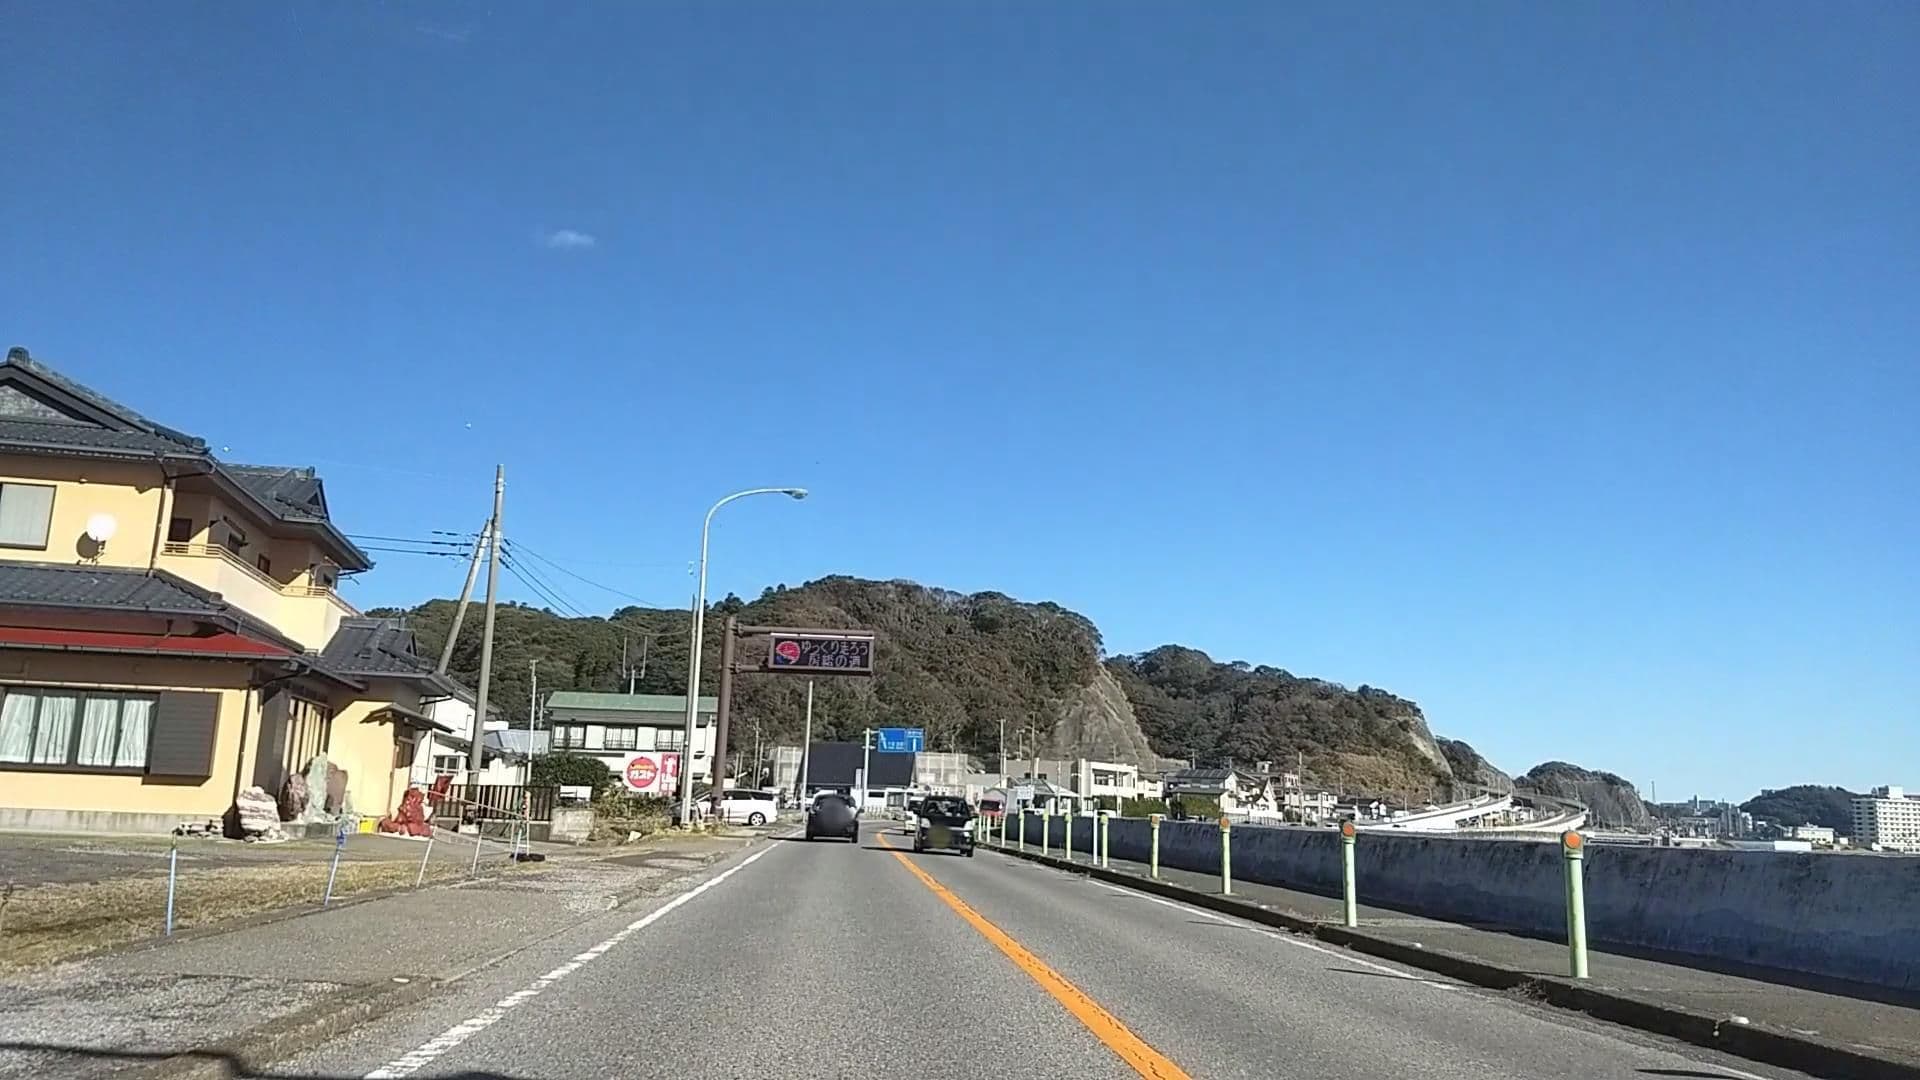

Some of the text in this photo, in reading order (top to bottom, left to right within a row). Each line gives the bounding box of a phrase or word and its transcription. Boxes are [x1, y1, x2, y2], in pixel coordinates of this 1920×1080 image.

[801, 640, 868, 655] ゆっくり走ろう
